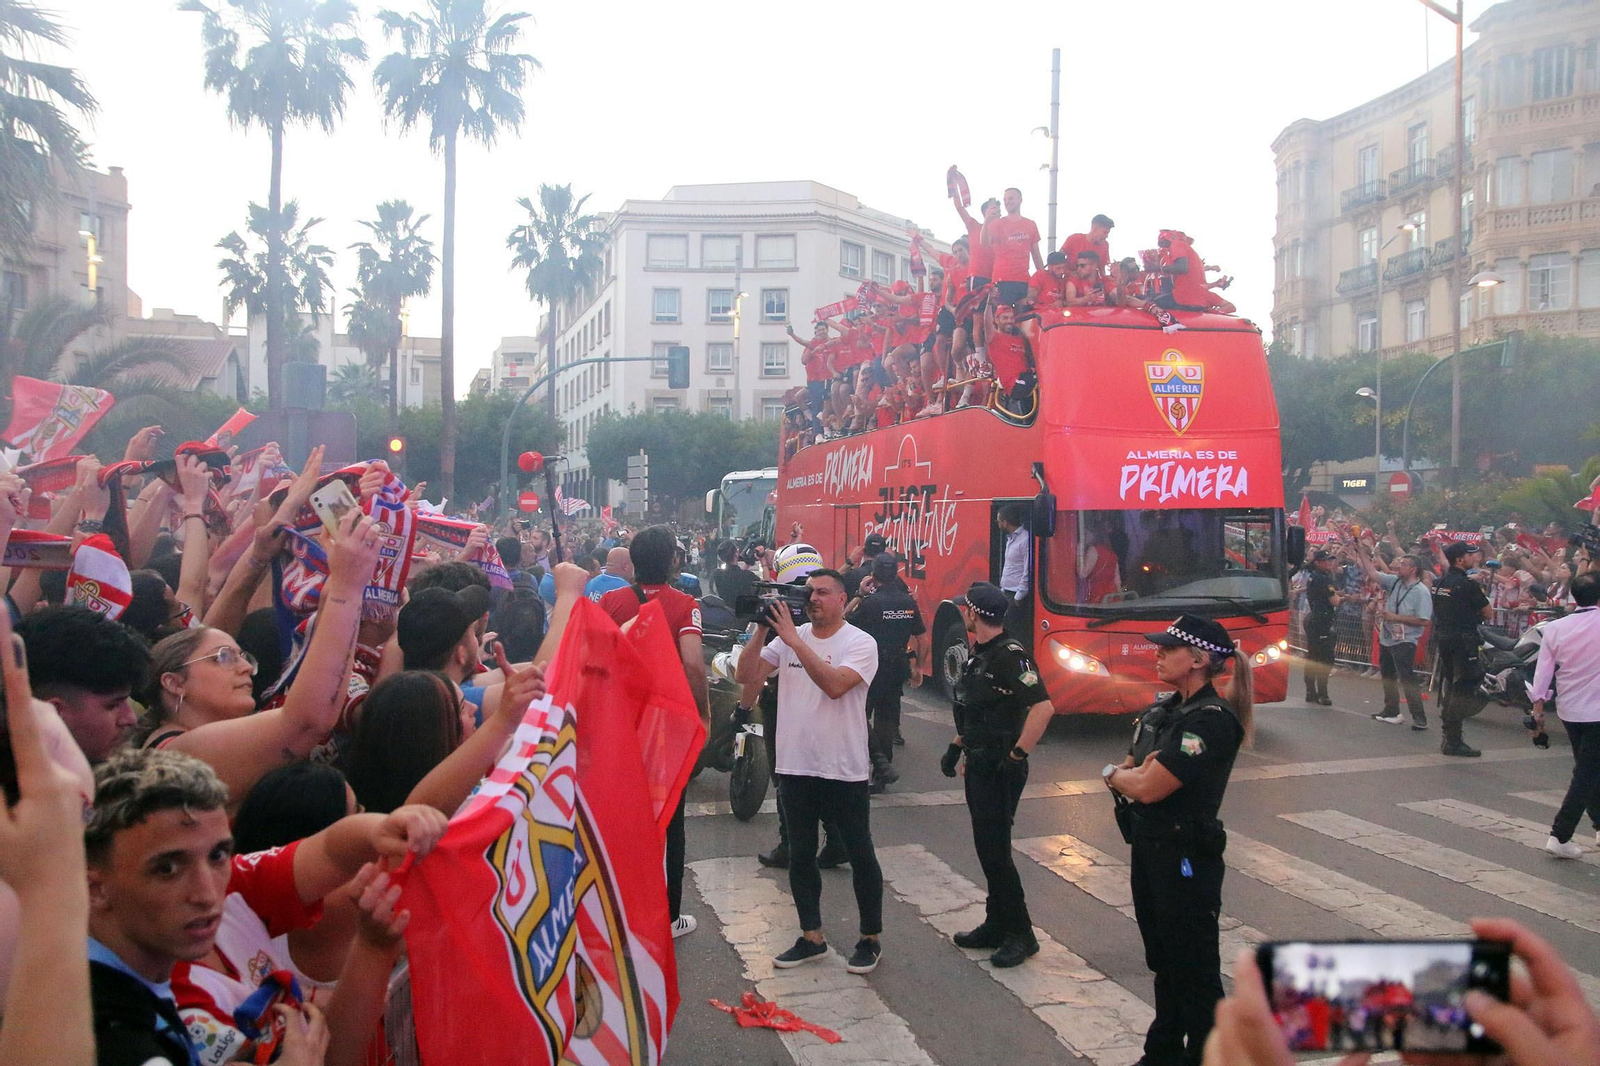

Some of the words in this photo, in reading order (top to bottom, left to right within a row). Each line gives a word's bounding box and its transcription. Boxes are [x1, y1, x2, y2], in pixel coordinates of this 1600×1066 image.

[1152, 366, 1165, 378] U
[1185, 367, 1197, 378] D
[1154, 384, 1200, 393] ALMERIA
[1195, 450, 1215, 460] ES
[1217, 450, 1238, 460] DE
[823, 444, 874, 498] PRIMERA
[1119, 461, 1248, 504] PRIMERA
[1342, 479, 1367, 488] TIGER
[874, 484, 937, 525] JUST
[365, 587, 399, 605] ALMERIA
[208, 1029, 236, 1065] LaLiga
